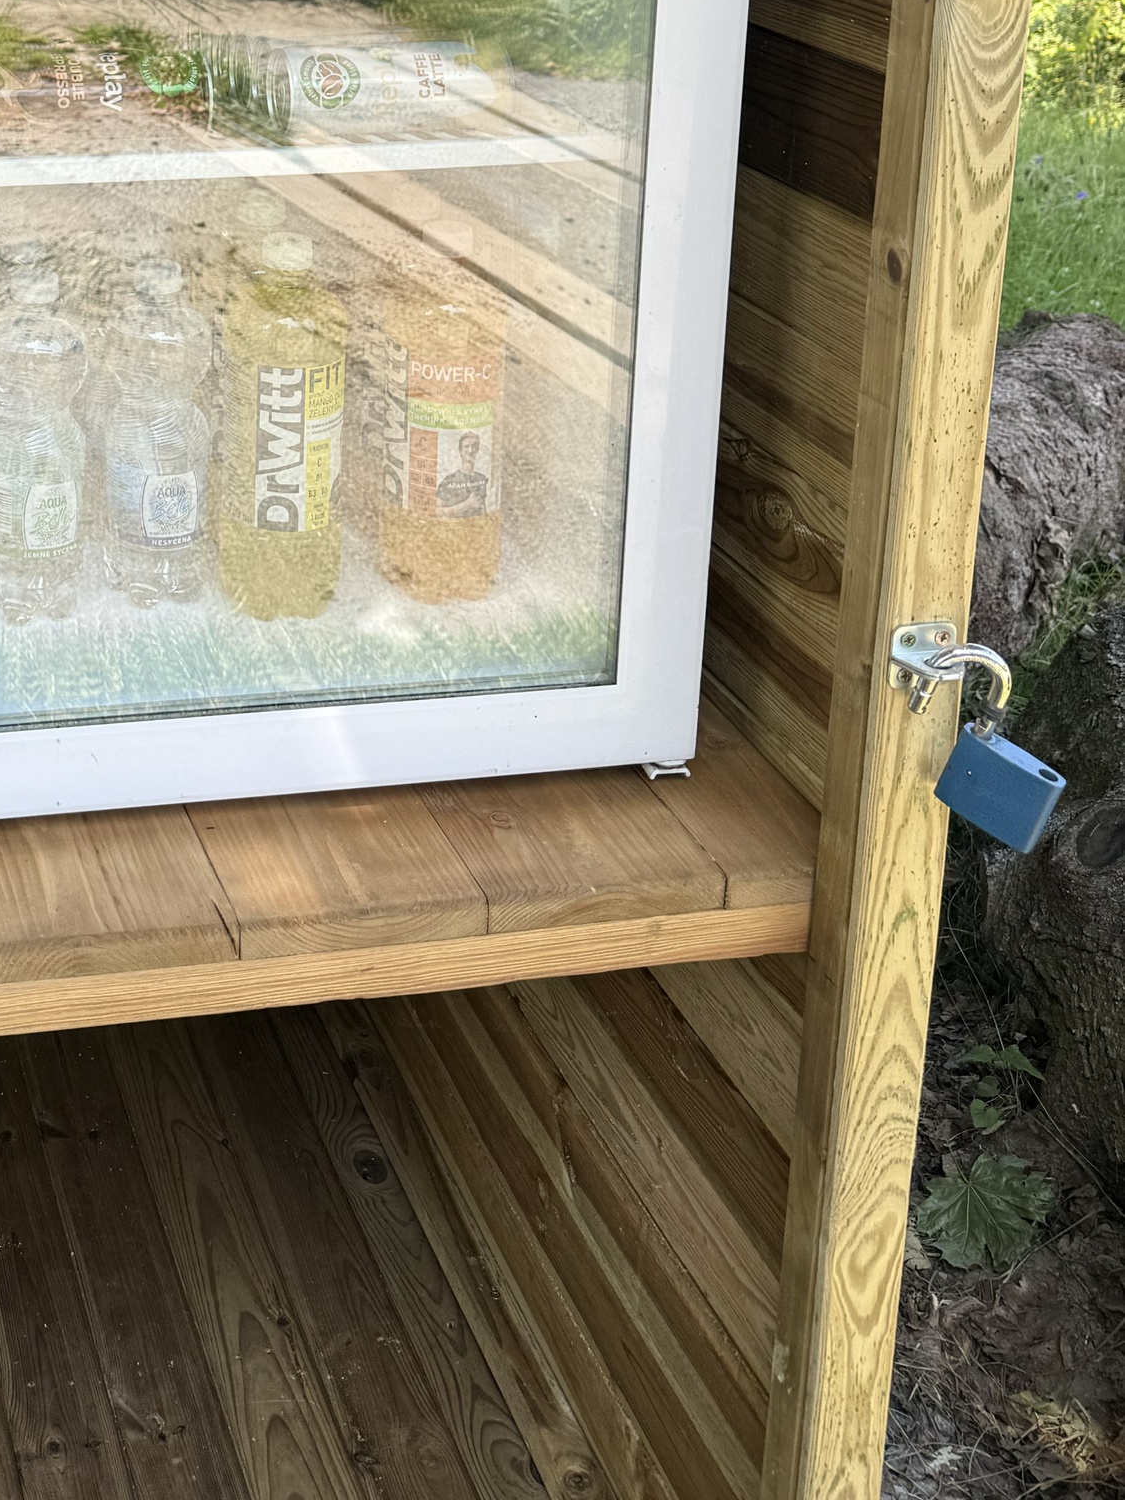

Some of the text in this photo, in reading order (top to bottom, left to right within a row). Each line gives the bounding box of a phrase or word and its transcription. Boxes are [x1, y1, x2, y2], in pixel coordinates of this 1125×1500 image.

[95, 52, 127, 113] eplay
[428, 53, 447, 98] LATTE
[308, 360, 343, 394] FIT
[410, 360, 492, 383] POWER-C
[256, 367, 305, 533] DrWitt
[317, 457, 323, 468] C
[37, 496, 68, 510] AQUA
[156, 486, 187, 498] AQUA
